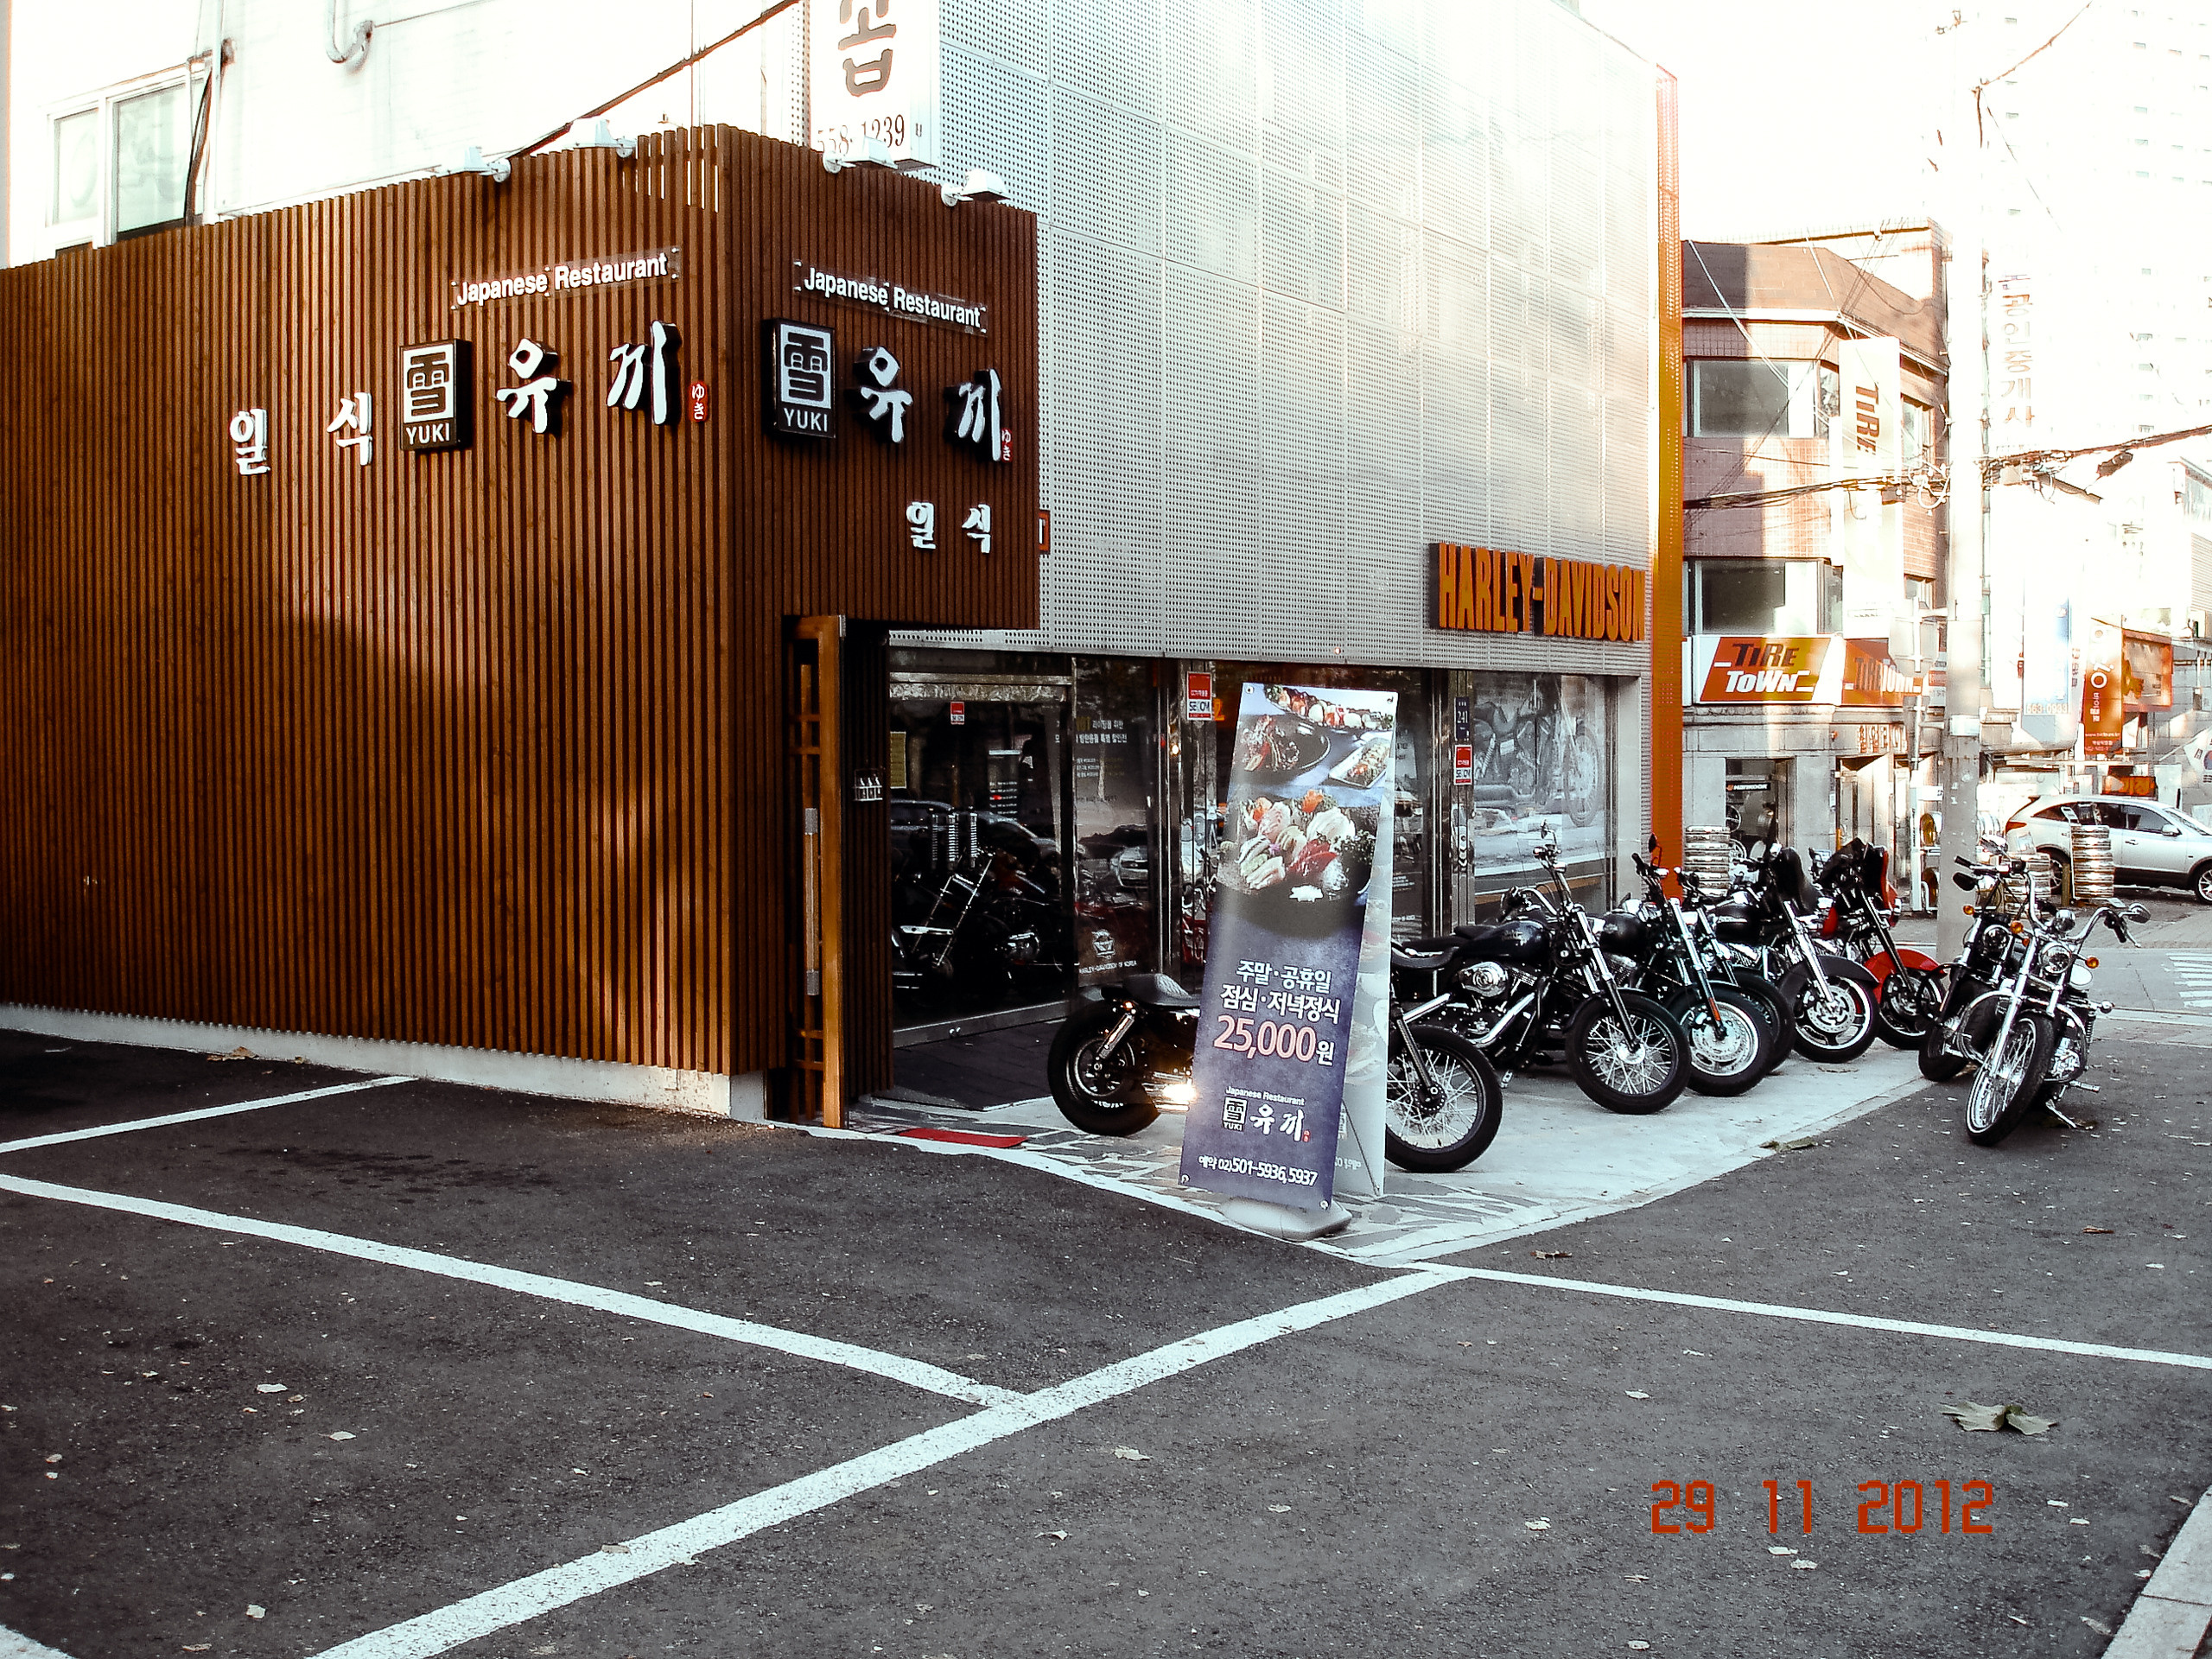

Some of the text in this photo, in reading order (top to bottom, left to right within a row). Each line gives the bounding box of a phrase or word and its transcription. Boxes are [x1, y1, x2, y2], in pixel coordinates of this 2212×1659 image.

[457, 252, 668, 307] Japanese Restaurant
[804, 267, 982, 328] Japanese Restaurant
[406, 423, 451, 445] YUKI
[783, 407, 829, 432] YUKI
[1438, 542, 1645, 642] HARLEY-DAVIDSON
[1236, 959, 1332, 995] 주말·공휴일
[1219, 983, 1342, 1026] 점심·저녁정식
[1213, 1014, 1335, 1066] 25,000원
[1225, 1085, 1306, 1106] Japanese Restaurant
[1224, 1122, 1243, 1131] YUKI
[1198, 1155, 1217, 1170] 예약
